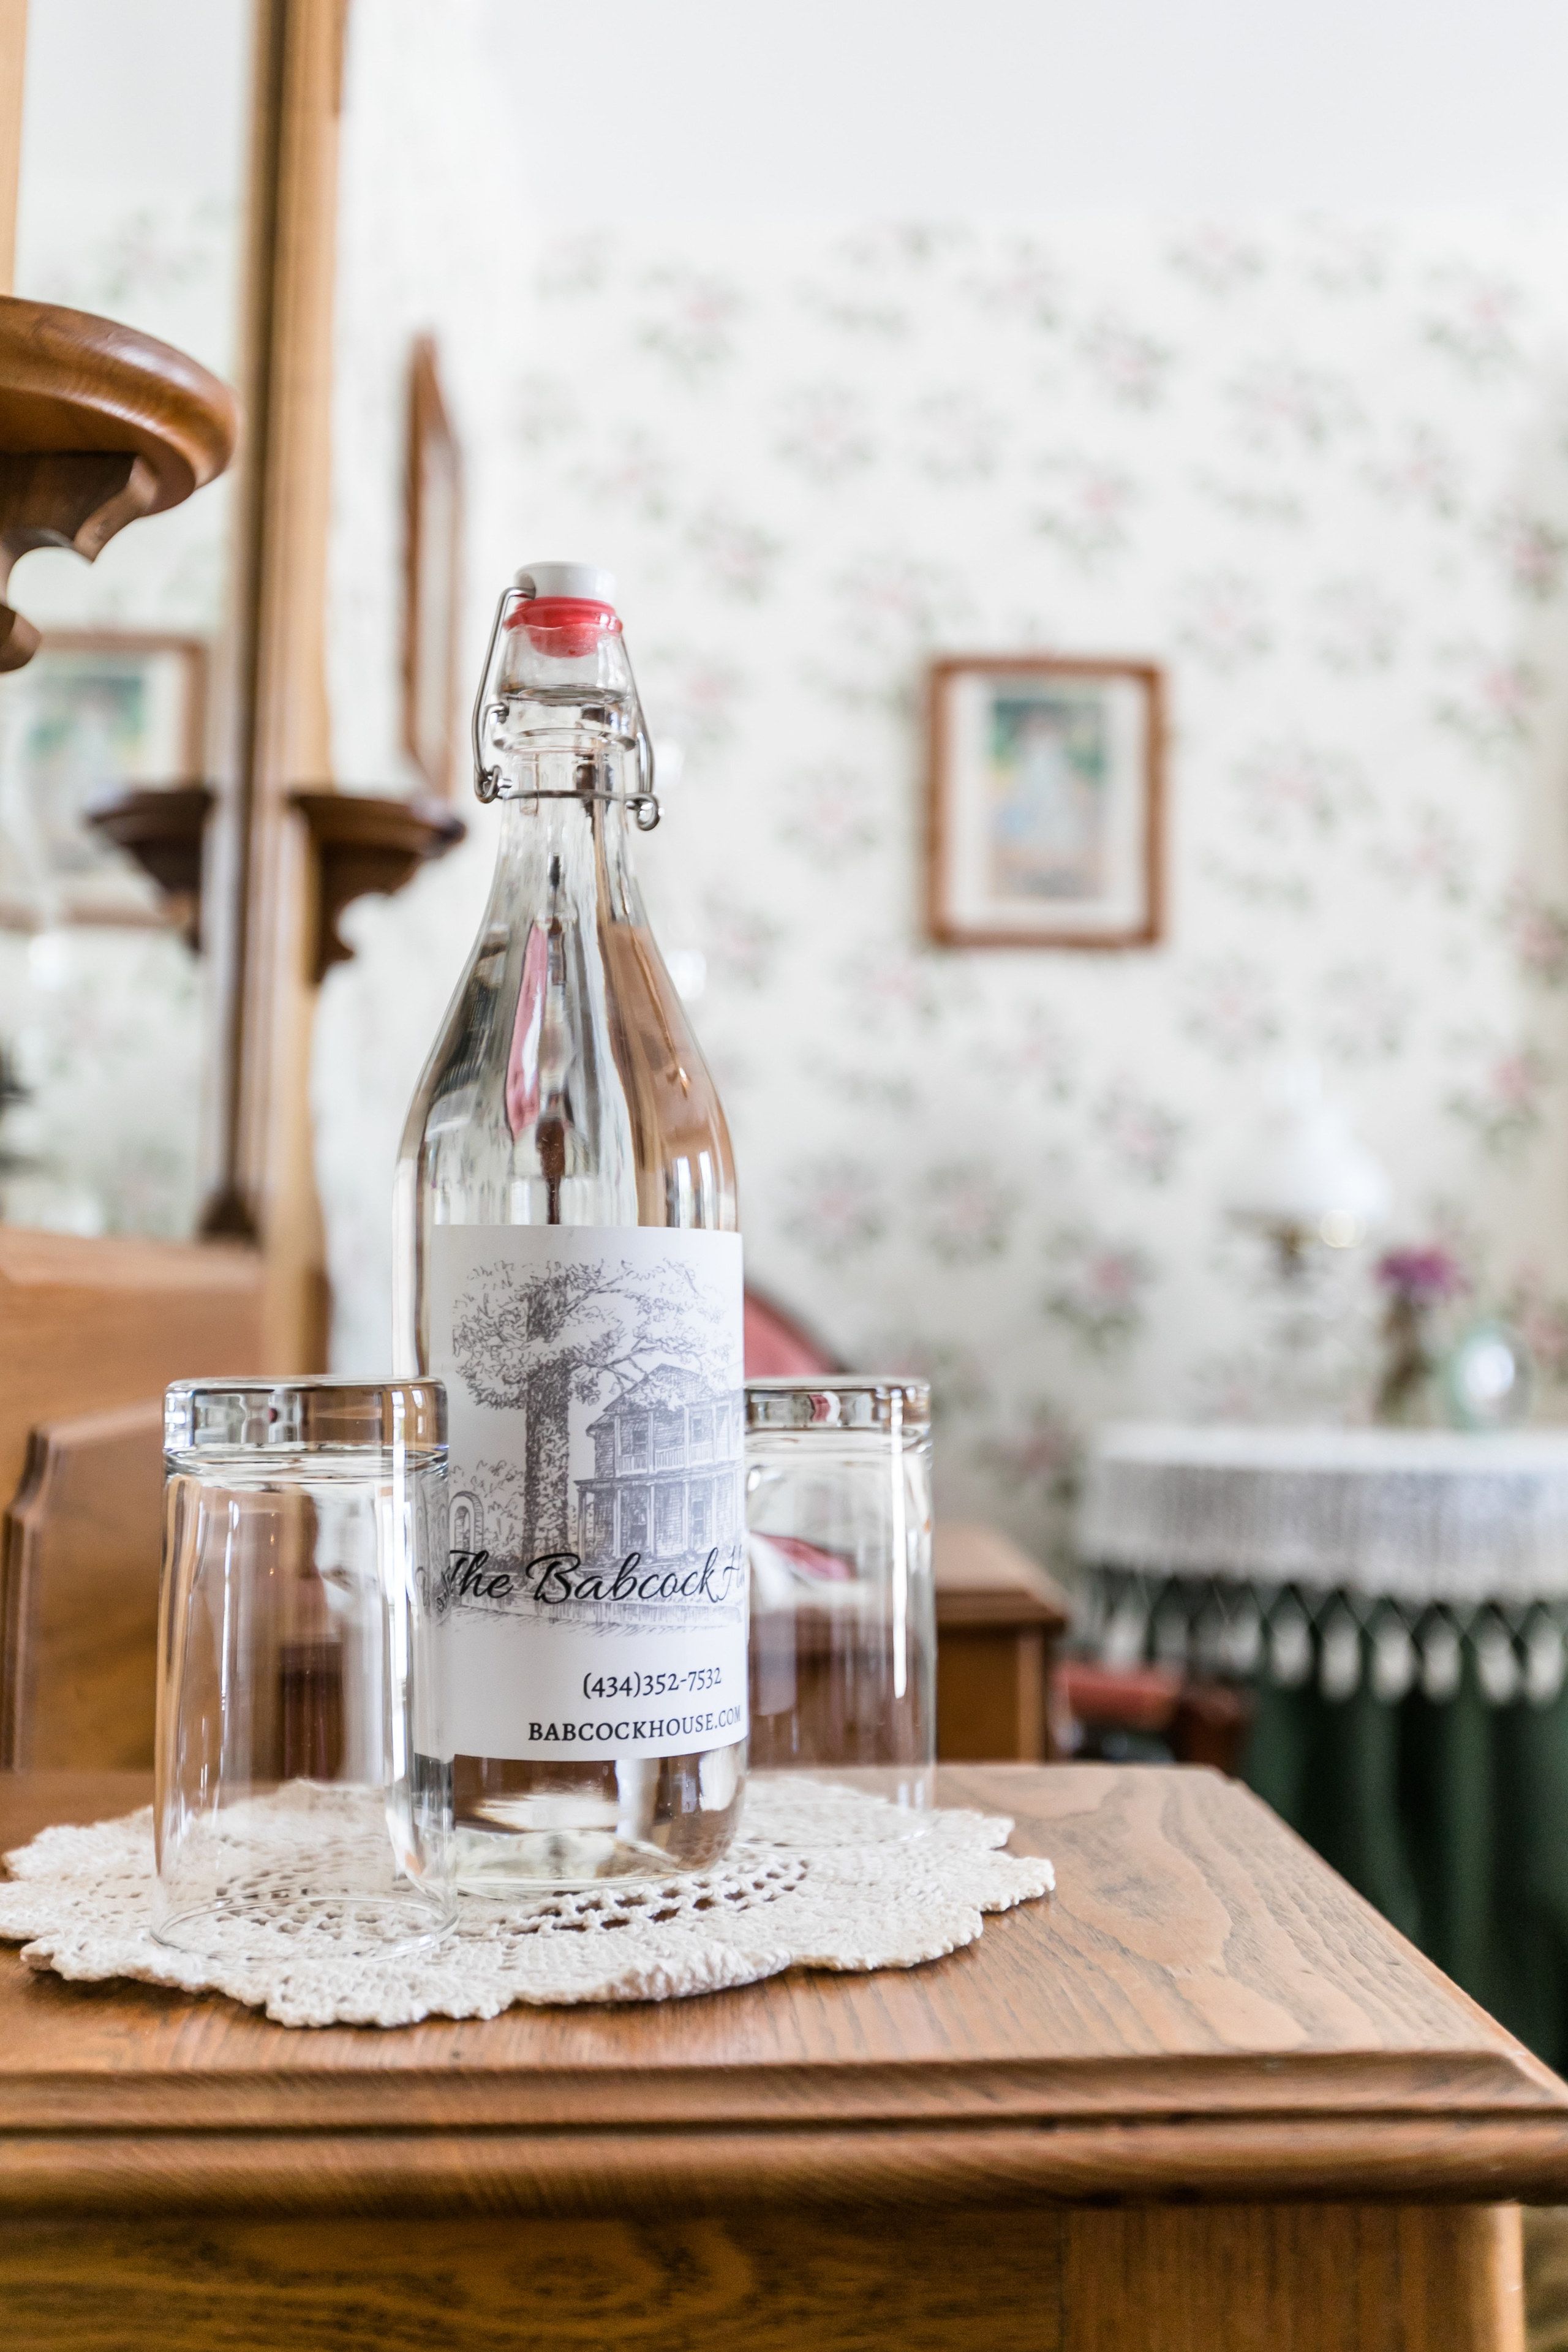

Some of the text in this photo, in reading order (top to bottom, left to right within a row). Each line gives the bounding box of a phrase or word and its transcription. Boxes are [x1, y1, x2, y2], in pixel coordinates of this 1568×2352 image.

[449, 1550, 514, 1599] The
[525, 1547, 718, 1604] Babcock
[583, 1667, 722, 1699] (434)352-7532
[528, 1705, 741, 1742] BABCOCKHOUSE.COM
